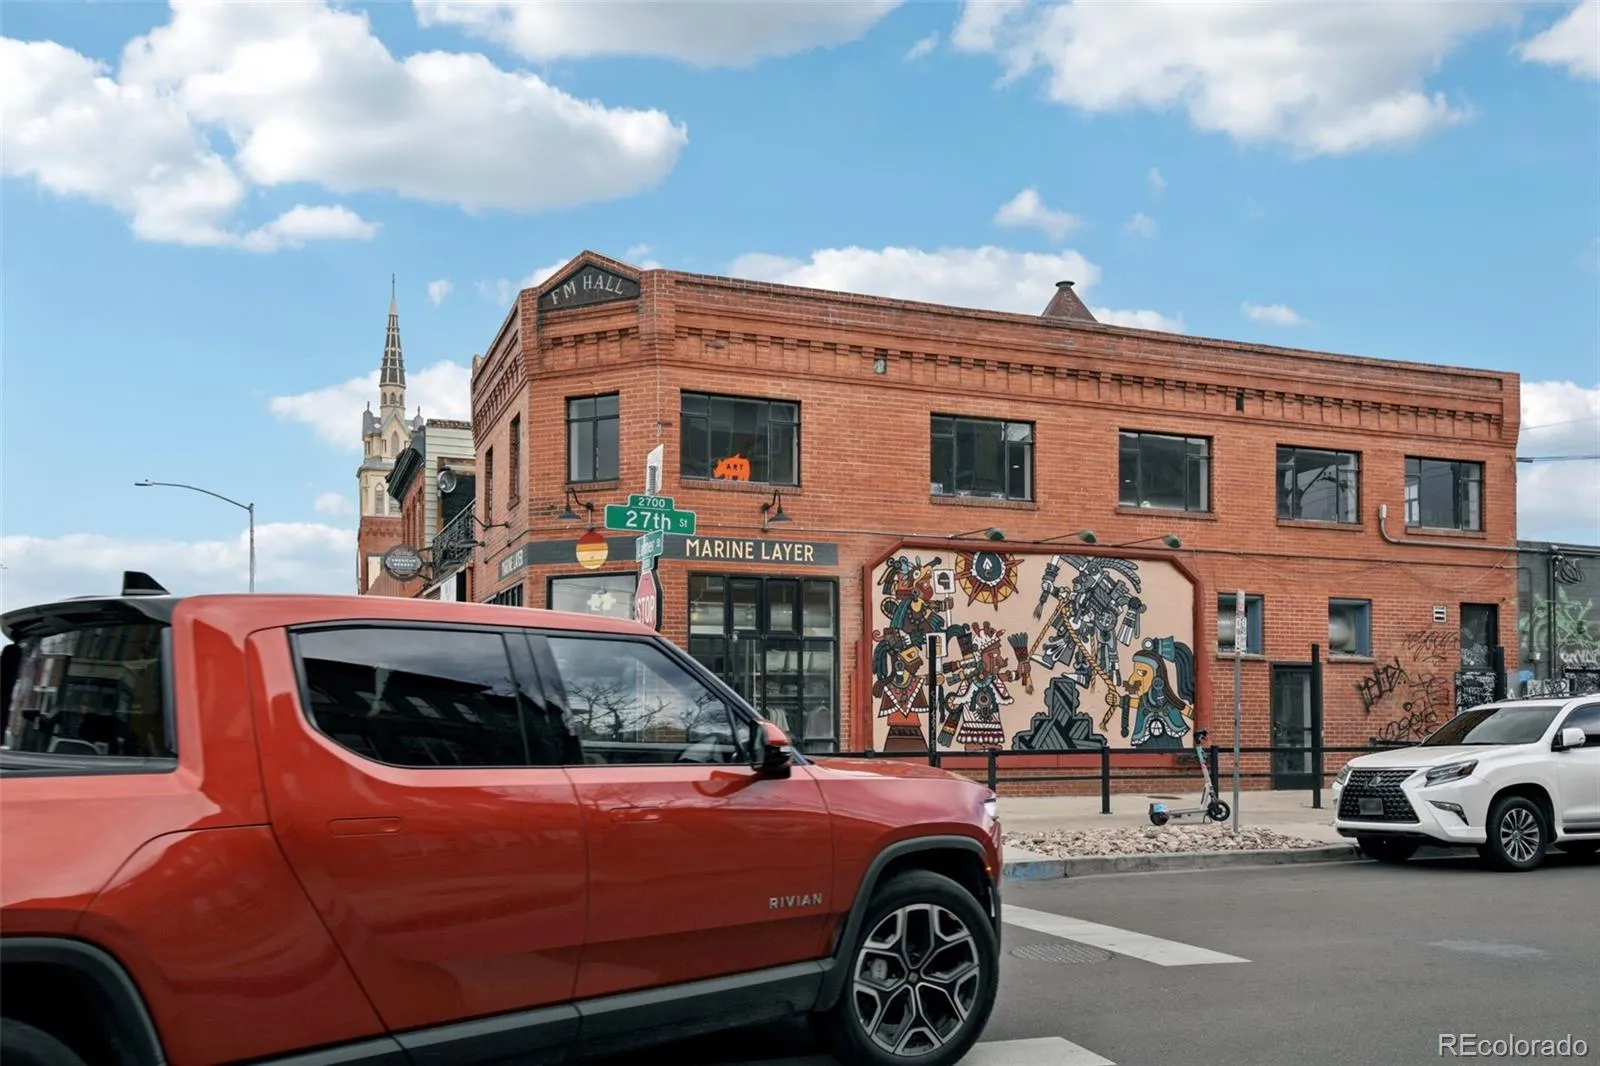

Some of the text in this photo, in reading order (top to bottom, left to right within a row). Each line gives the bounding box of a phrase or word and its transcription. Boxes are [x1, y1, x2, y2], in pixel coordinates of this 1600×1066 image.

[551, 275, 624, 305] FM HALL
[726, 463, 744, 471] ART
[638, 497, 666, 508] 2700
[626, 510, 688, 530] 27th St
[686, 538, 814, 562] MARINE LAYER
[637, 595, 655, 624] STOP
[769, 893, 822, 909] RIVIAN
